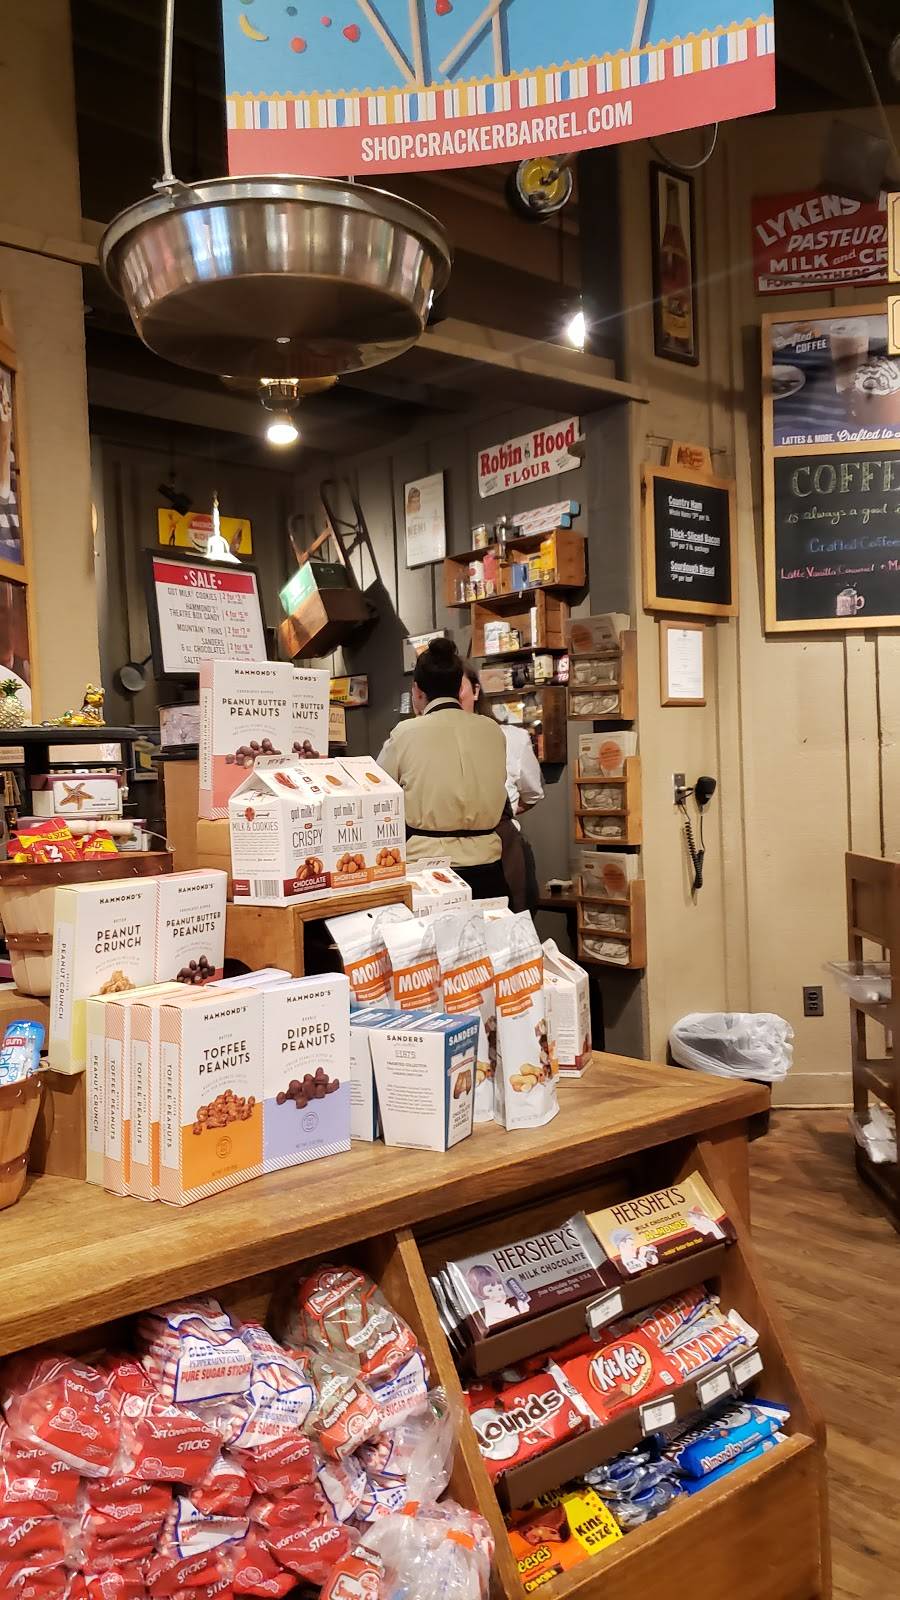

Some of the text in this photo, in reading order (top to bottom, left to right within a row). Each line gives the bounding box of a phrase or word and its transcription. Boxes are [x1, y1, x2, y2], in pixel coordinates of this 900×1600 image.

[361, 100, 633, 162] SHOP.CRACKERBARREL.COM
[756, 194, 861, 248] LYKENS
[770, 253, 830, 273] MILK
[832, 248, 857, 266] and
[795, 339, 828, 354] COFFEE
[782, 435, 806, 445] LATTES
[836, 428, 881, 442] Crafted
[882, 427, 894, 439] to
[480, 421, 576, 478] Robin Hood
[503, 460, 551, 487] FLOUR
[668, 495, 703, 510] Country Ham
[803, 504, 847, 525] always
[850, 508, 858, 516] a
[862, 503, 888, 524] good
[669, 527, 721, 544] Thick-Sliced Bacon
[810, 537, 857, 553] Crafted
[670, 560, 715, 575] Sourdough Bread
[189, 569, 218, 589] SALE
[167, 587, 178, 596] GOT
[195, 591, 218, 600] COOKIES
[169, 608, 192, 619] THEATRE
[203, 613, 220, 622] CANDY
[193, 645, 226, 655] CHOCOLATES
[234, 643, 242, 651] for
[201, 638, 225, 647] SANDERS
[234, 668, 277, 677] HAMMOND'S
[222, 698, 287, 707] PEANUT BUTTER
[300, 703, 324, 711] BUTTER
[230, 707, 280, 717] PEANUTS
[252, 821, 279, 832] COOKIES
[376, 823, 399, 840] MINI
[292, 828, 323, 848] CRISPY
[338, 827, 362, 844] MINI
[178, 883, 215, 894] HAMMOND'S
[292, 875, 327, 889] CHOCOLATE
[99, 892, 143, 905] HAMMOND'S
[166, 911, 222, 927] PEANUT BUTTER
[97, 924, 142, 942] PEANUT
[172, 921, 215, 938] PEANUTS
[94, 936, 143, 954] CRUNCH
[58, 981, 66, 1020] CRUNCH
[286, 989, 332, 1004] HAMMOND'S
[203, 1005, 248, 1021] HAMMOND'S
[287, 1022, 330, 1040] DIPPED
[386, 1034, 424, 1043] SANDERS
[448, 1024, 479, 1047] SANDERS
[203, 1040, 247, 1061] TOFFEE
[281, 1033, 336, 1053] PEANUTS
[199, 1052, 251, 1076] PEANUTS
[610, 1187, 687, 1226] HERSHEY'S
[649, 1211, 682, 1227] CHOCOLATE
[643, 1218, 689, 1242] ALMONDS
[492, 1227, 581, 1273] HERSHEY'S
[518, 1252, 587, 1282] MILK CHOCOLATE
[181, 1371, 200, 1383] PURE
[201, 1367, 226, 1380] SUGAR
[67, 1380, 85, 1393] SOFT
[176, 1439, 211, 1454] STICKS
[280, 1445, 310, 1465] STICKS
[308, 1526, 341, 1552] STICKS
[176, 1557, 208, 1584] STICKS
